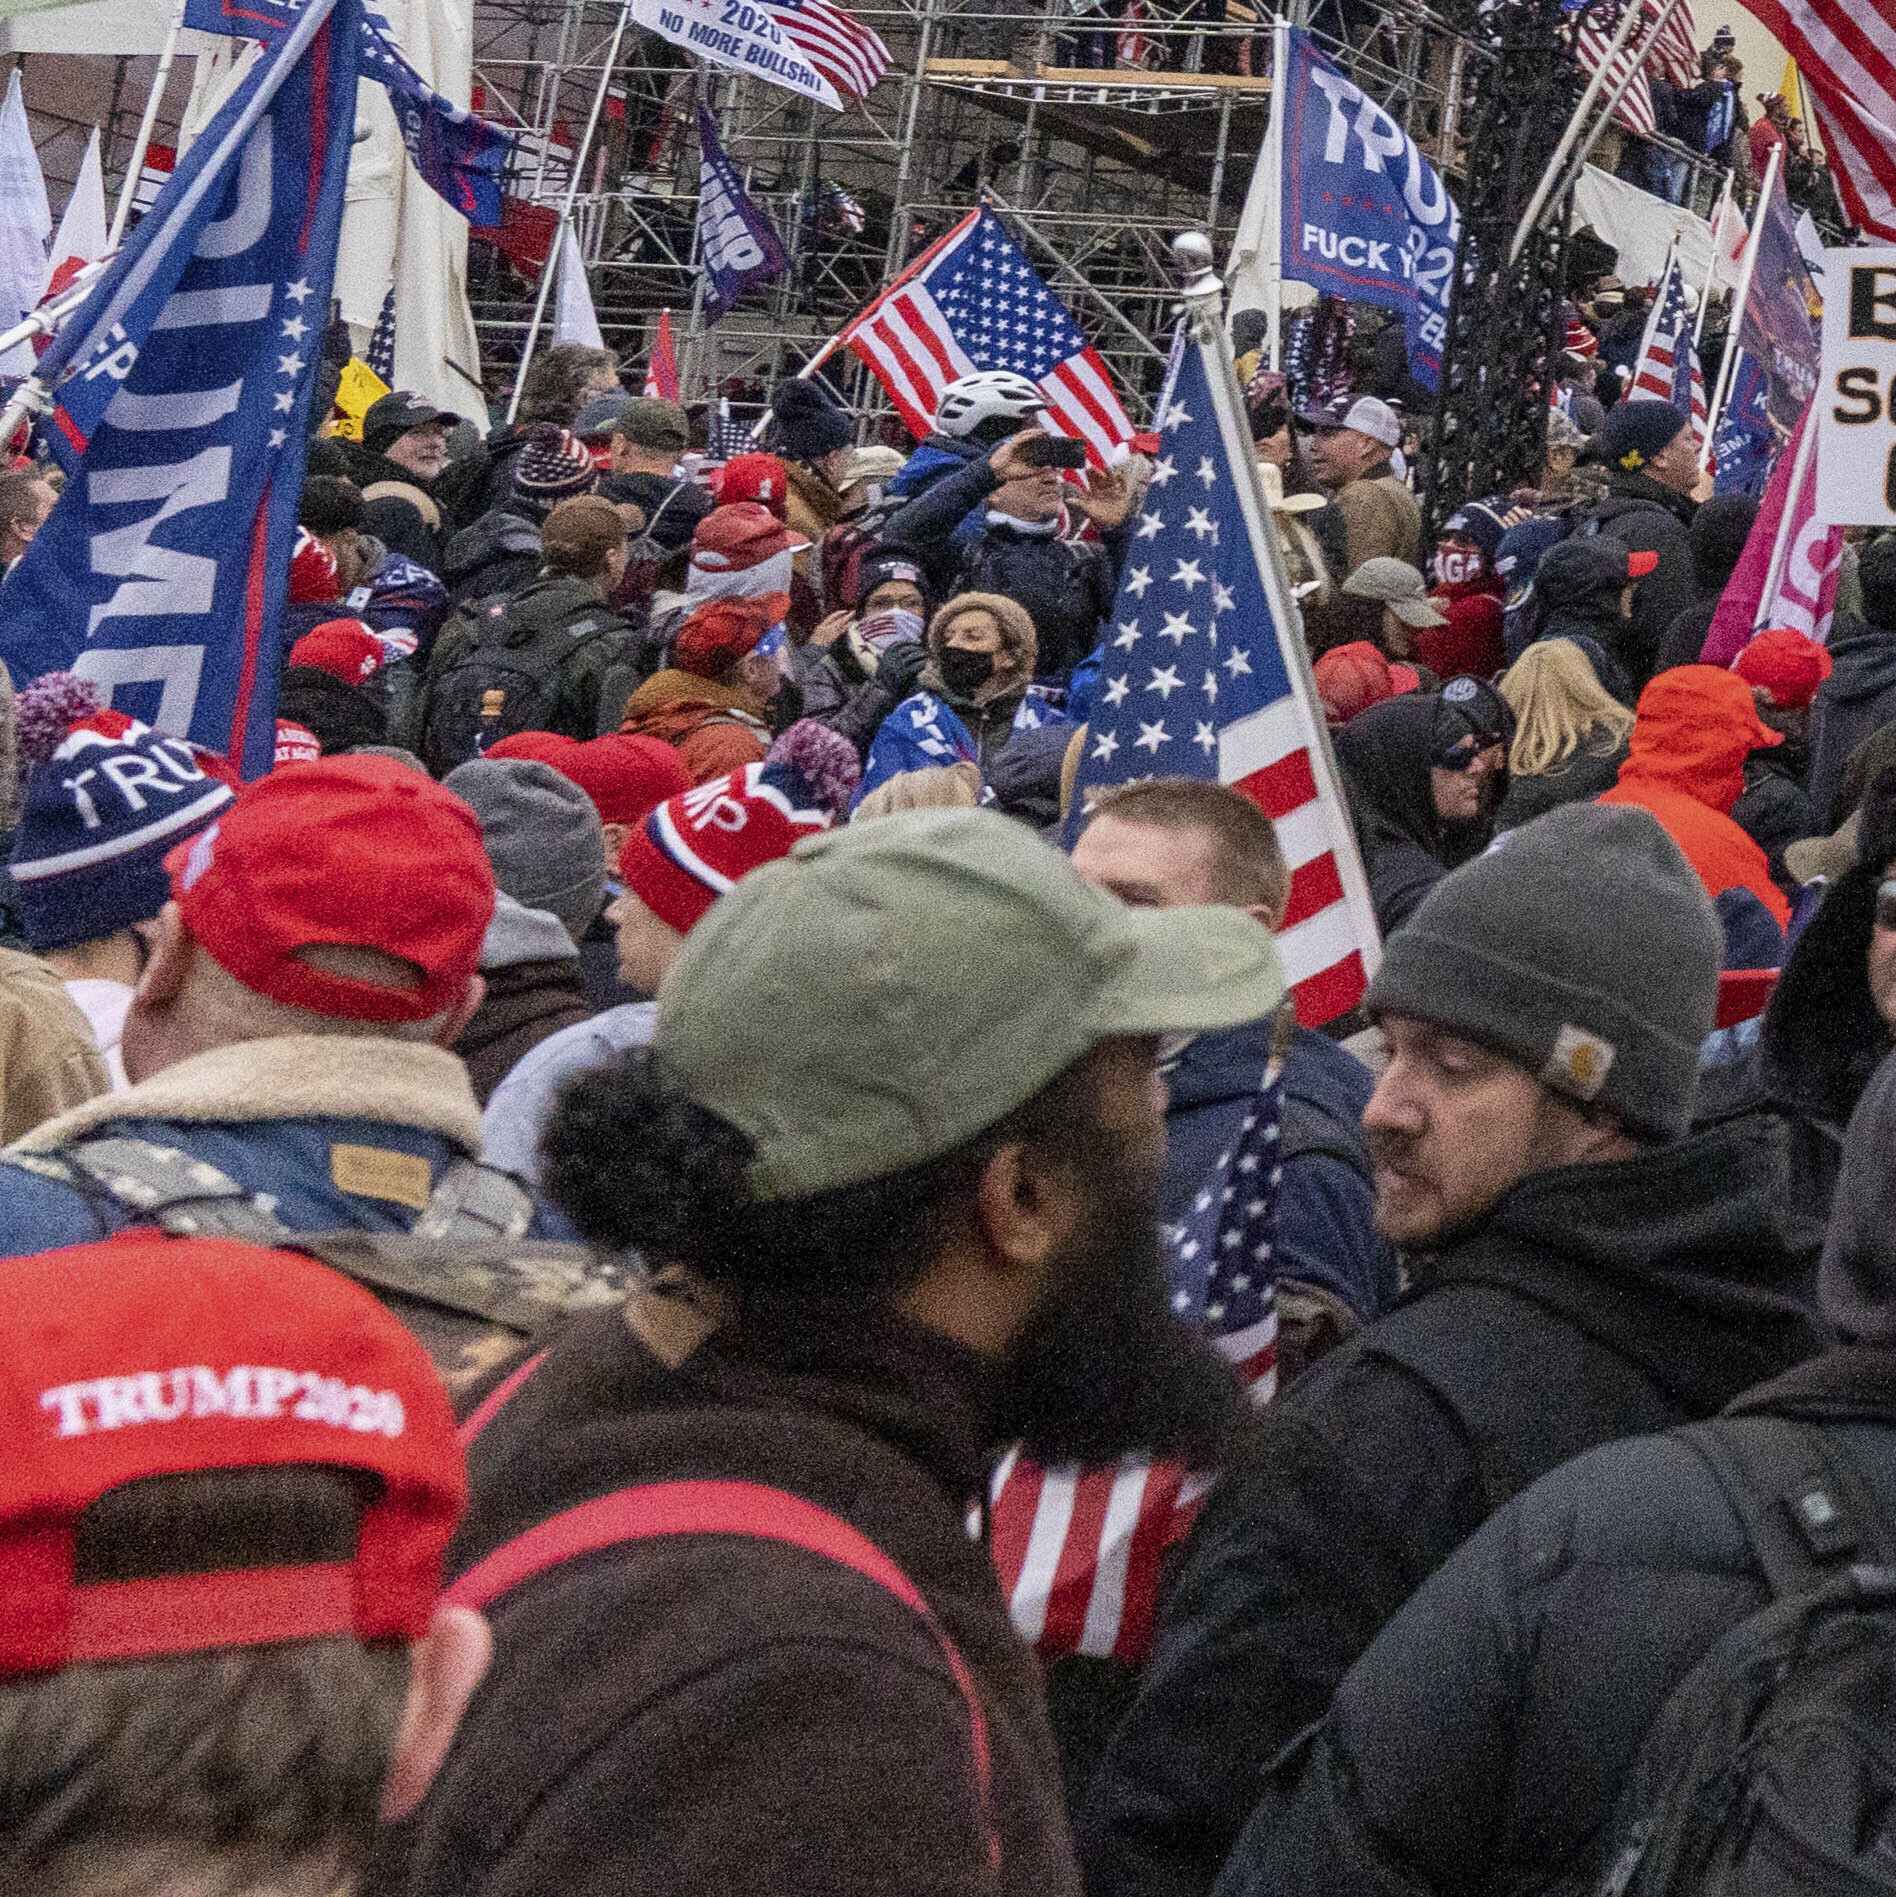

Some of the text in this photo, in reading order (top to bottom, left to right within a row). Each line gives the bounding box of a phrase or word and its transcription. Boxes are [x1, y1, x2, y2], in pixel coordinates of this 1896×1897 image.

[659, 9, 682, 35] NO
[687, 20, 742, 58] MORE
[1311, 66, 1460, 242] TRU
[1303, 223, 1390, 272] FUCK
[61, 738, 206, 828] TRU
